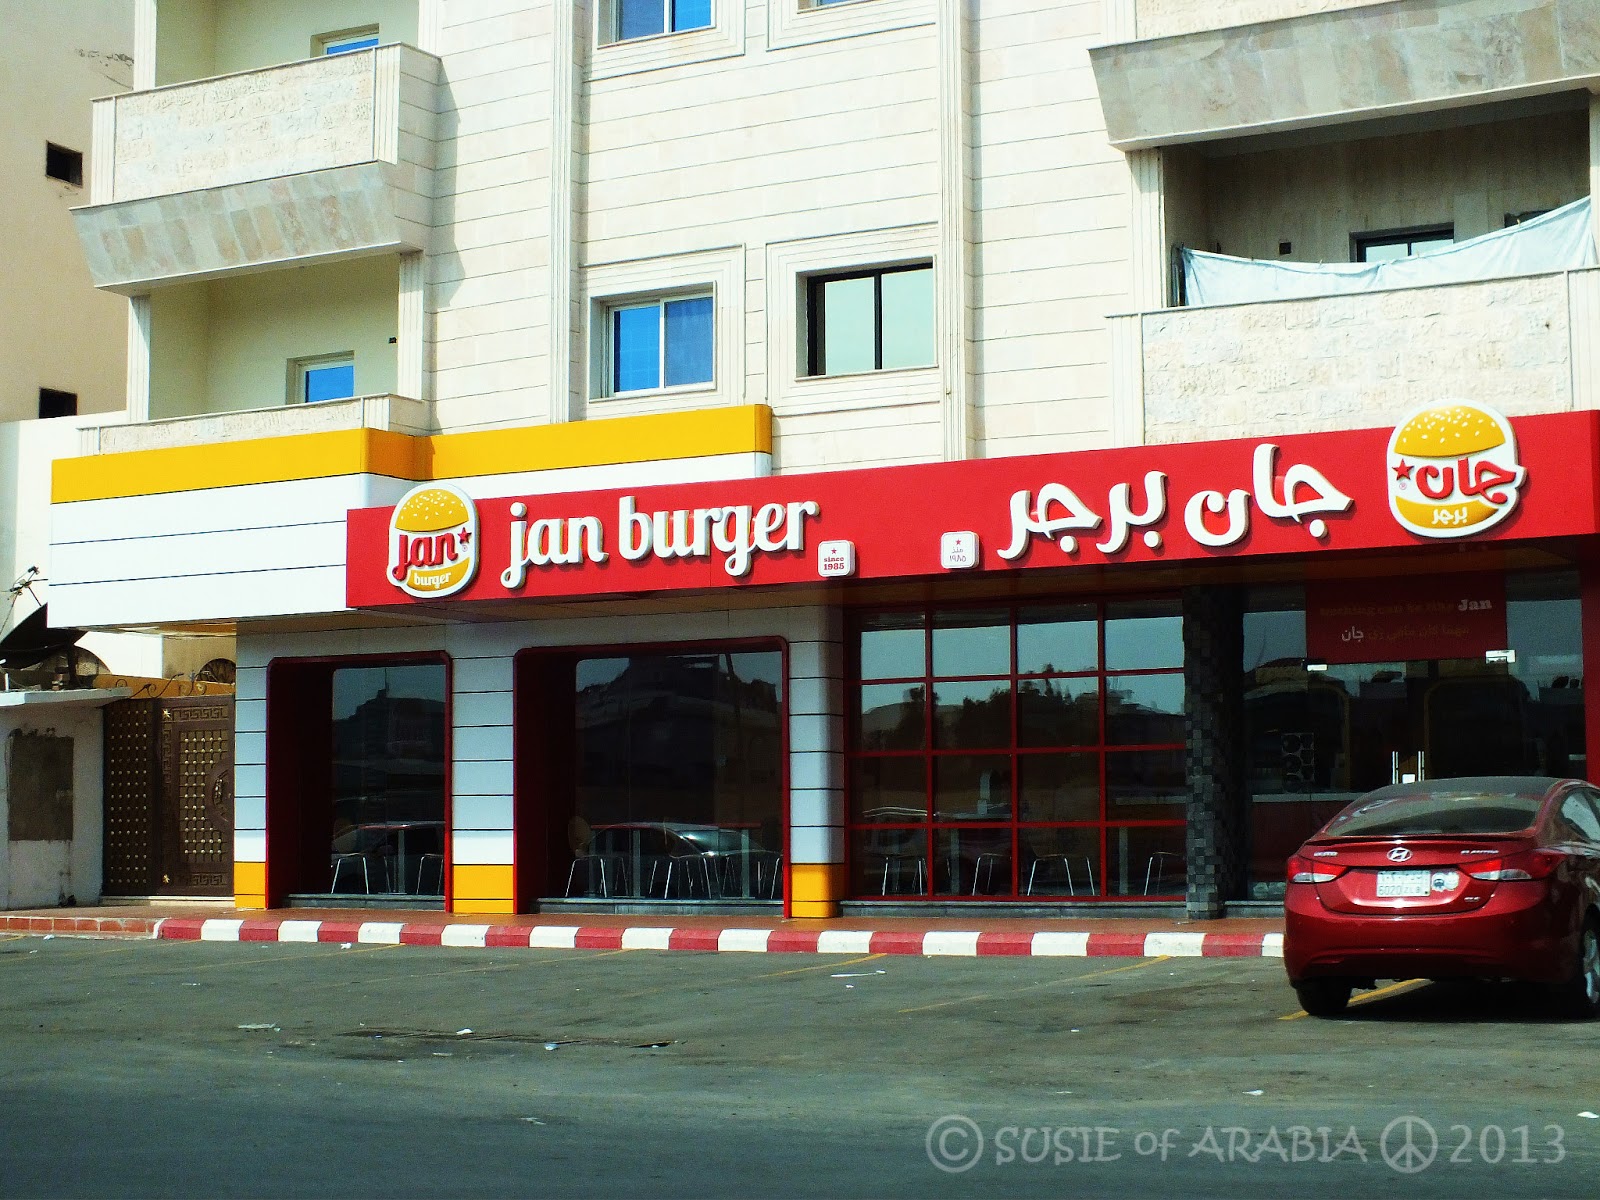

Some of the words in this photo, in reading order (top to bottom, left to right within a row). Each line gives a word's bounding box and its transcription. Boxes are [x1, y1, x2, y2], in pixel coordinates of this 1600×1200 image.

[1184, 443, 1355, 546] جان
[1415, 457, 1517, 505] جان
[997, 470, 1168, 560] برجر
[1431, 506, 1468, 525] برجر
[501, 502, 609, 590] jan
[618, 496, 821, 578] burger
[413, 572, 452, 589] burger
[823, 563, 845, 571] 1985
[1457, 599, 1493, 612] Jan
